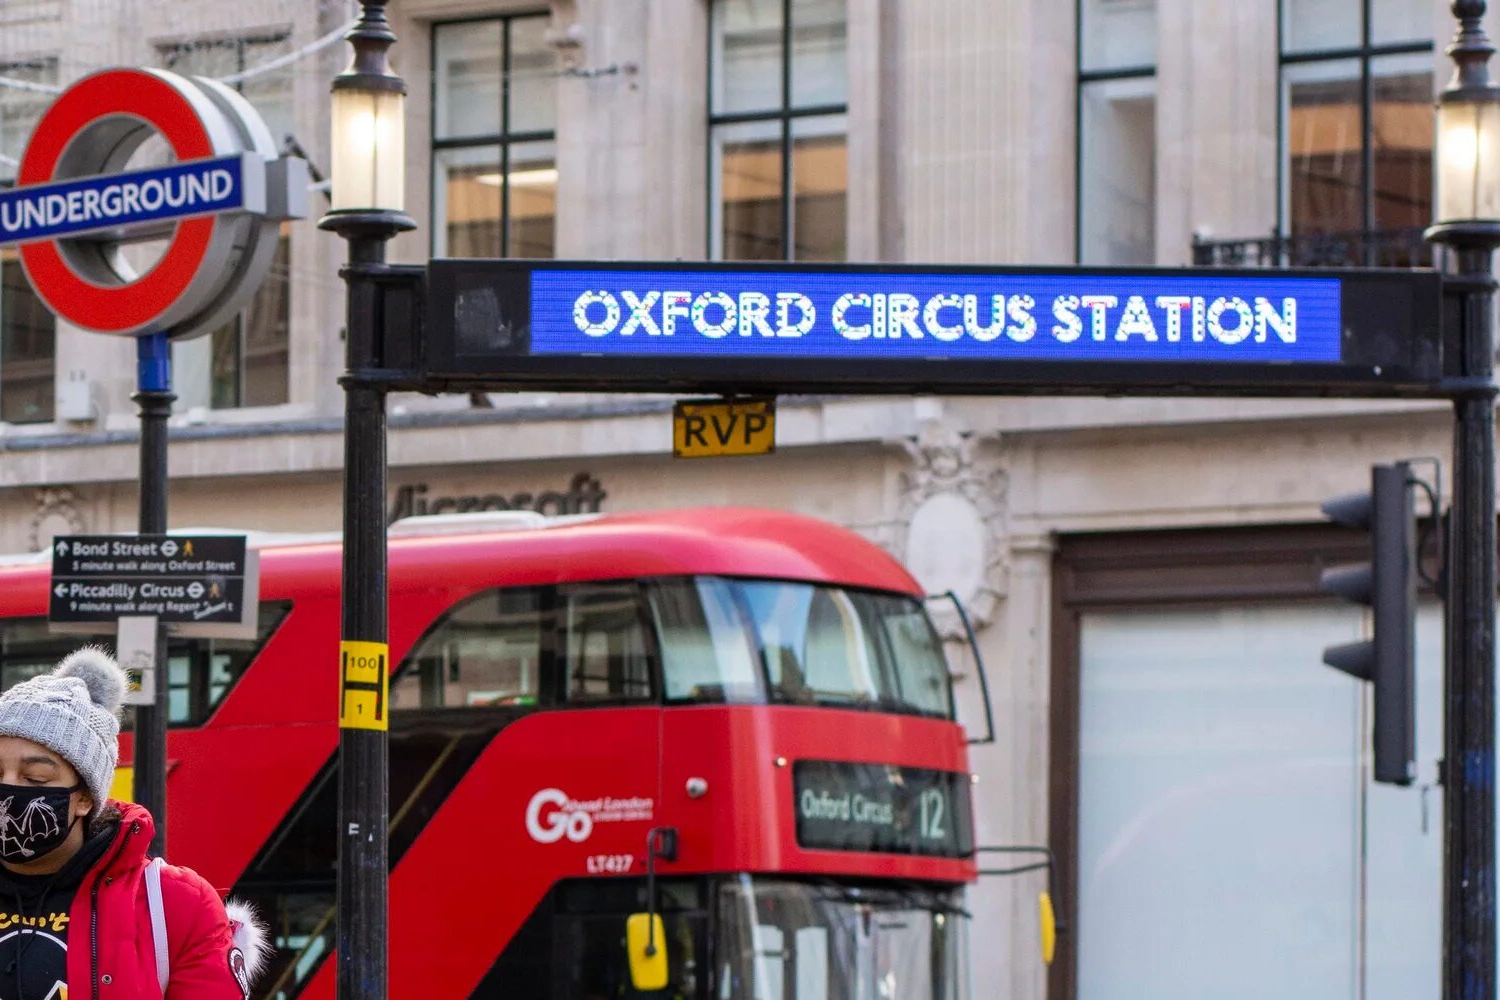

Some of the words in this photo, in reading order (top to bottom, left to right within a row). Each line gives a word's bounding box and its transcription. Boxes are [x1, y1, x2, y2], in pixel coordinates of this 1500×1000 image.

[0, 169, 234, 232] UNDERGROUND
[572, 290, 816, 339] OXFORD
[831, 292, 1037, 341] CIRCUS
[1051, 294, 1297, 344] STATION
[684, 413, 768, 447] RVP
[72, 541, 108, 556] Bond
[112, 541, 158, 556] Street
[81, 561, 114, 571] minute
[116, 561, 137, 571] walk
[140, 561, 166, 572] along
[168, 560, 203, 571] Oxford
[205, 560, 236, 571] Street
[70, 583, 136, 600] Piccadilly
[140, 583, 184, 598] Circus
[70, 602, 77, 611] 9
[79, 602, 112, 611] minute
[114, 602, 135, 611] walk
[138, 602, 164, 613] along
[166, 602, 200, 613] Regent
[350, 656, 377, 669] 100
[357, 703, 363, 714] 1
[525, 787, 593, 844] Go
[801, 788, 850, 821] Oxford
[852, 793, 894, 825] Circus
[920, 788, 945, 839] 12
